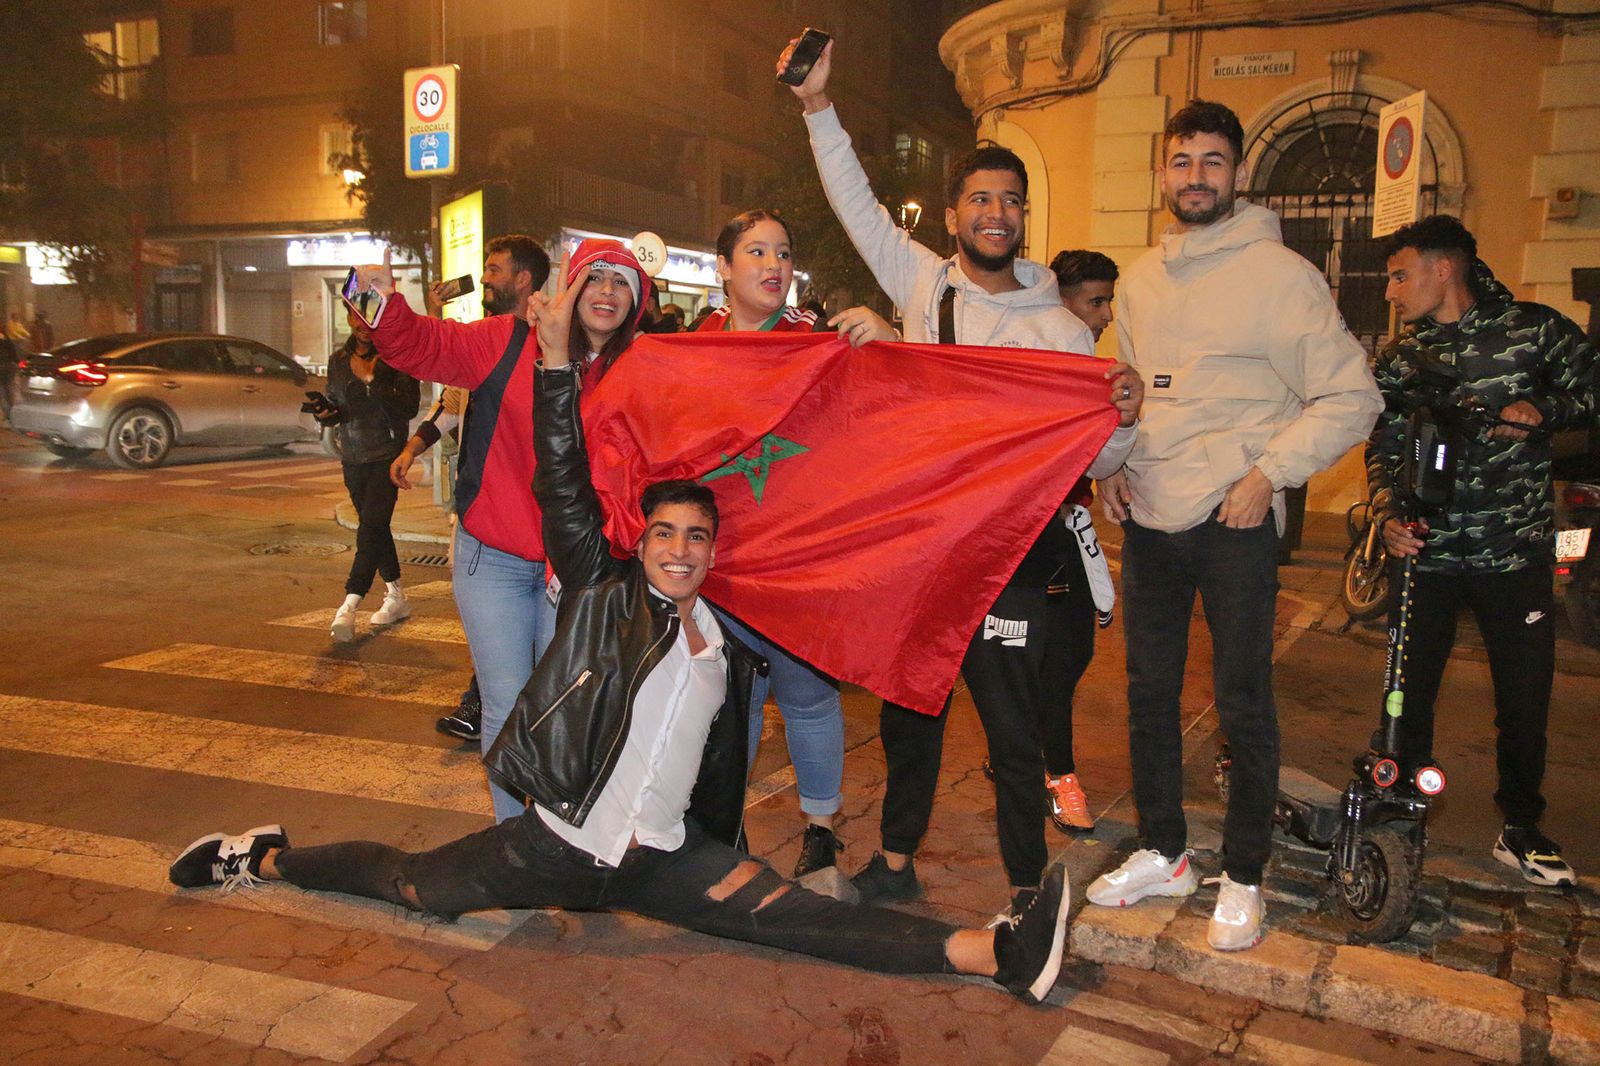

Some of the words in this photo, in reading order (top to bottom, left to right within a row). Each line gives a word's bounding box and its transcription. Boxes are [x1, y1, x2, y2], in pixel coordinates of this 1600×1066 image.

[1214, 64, 1246, 77] NICOLÁS
[1248, 61, 1290, 75] SALMERÓN
[419, 89, 440, 107] 30
[409, 122, 450, 134] CICLOCALLE
[984, 614, 1028, 636] PUMA
